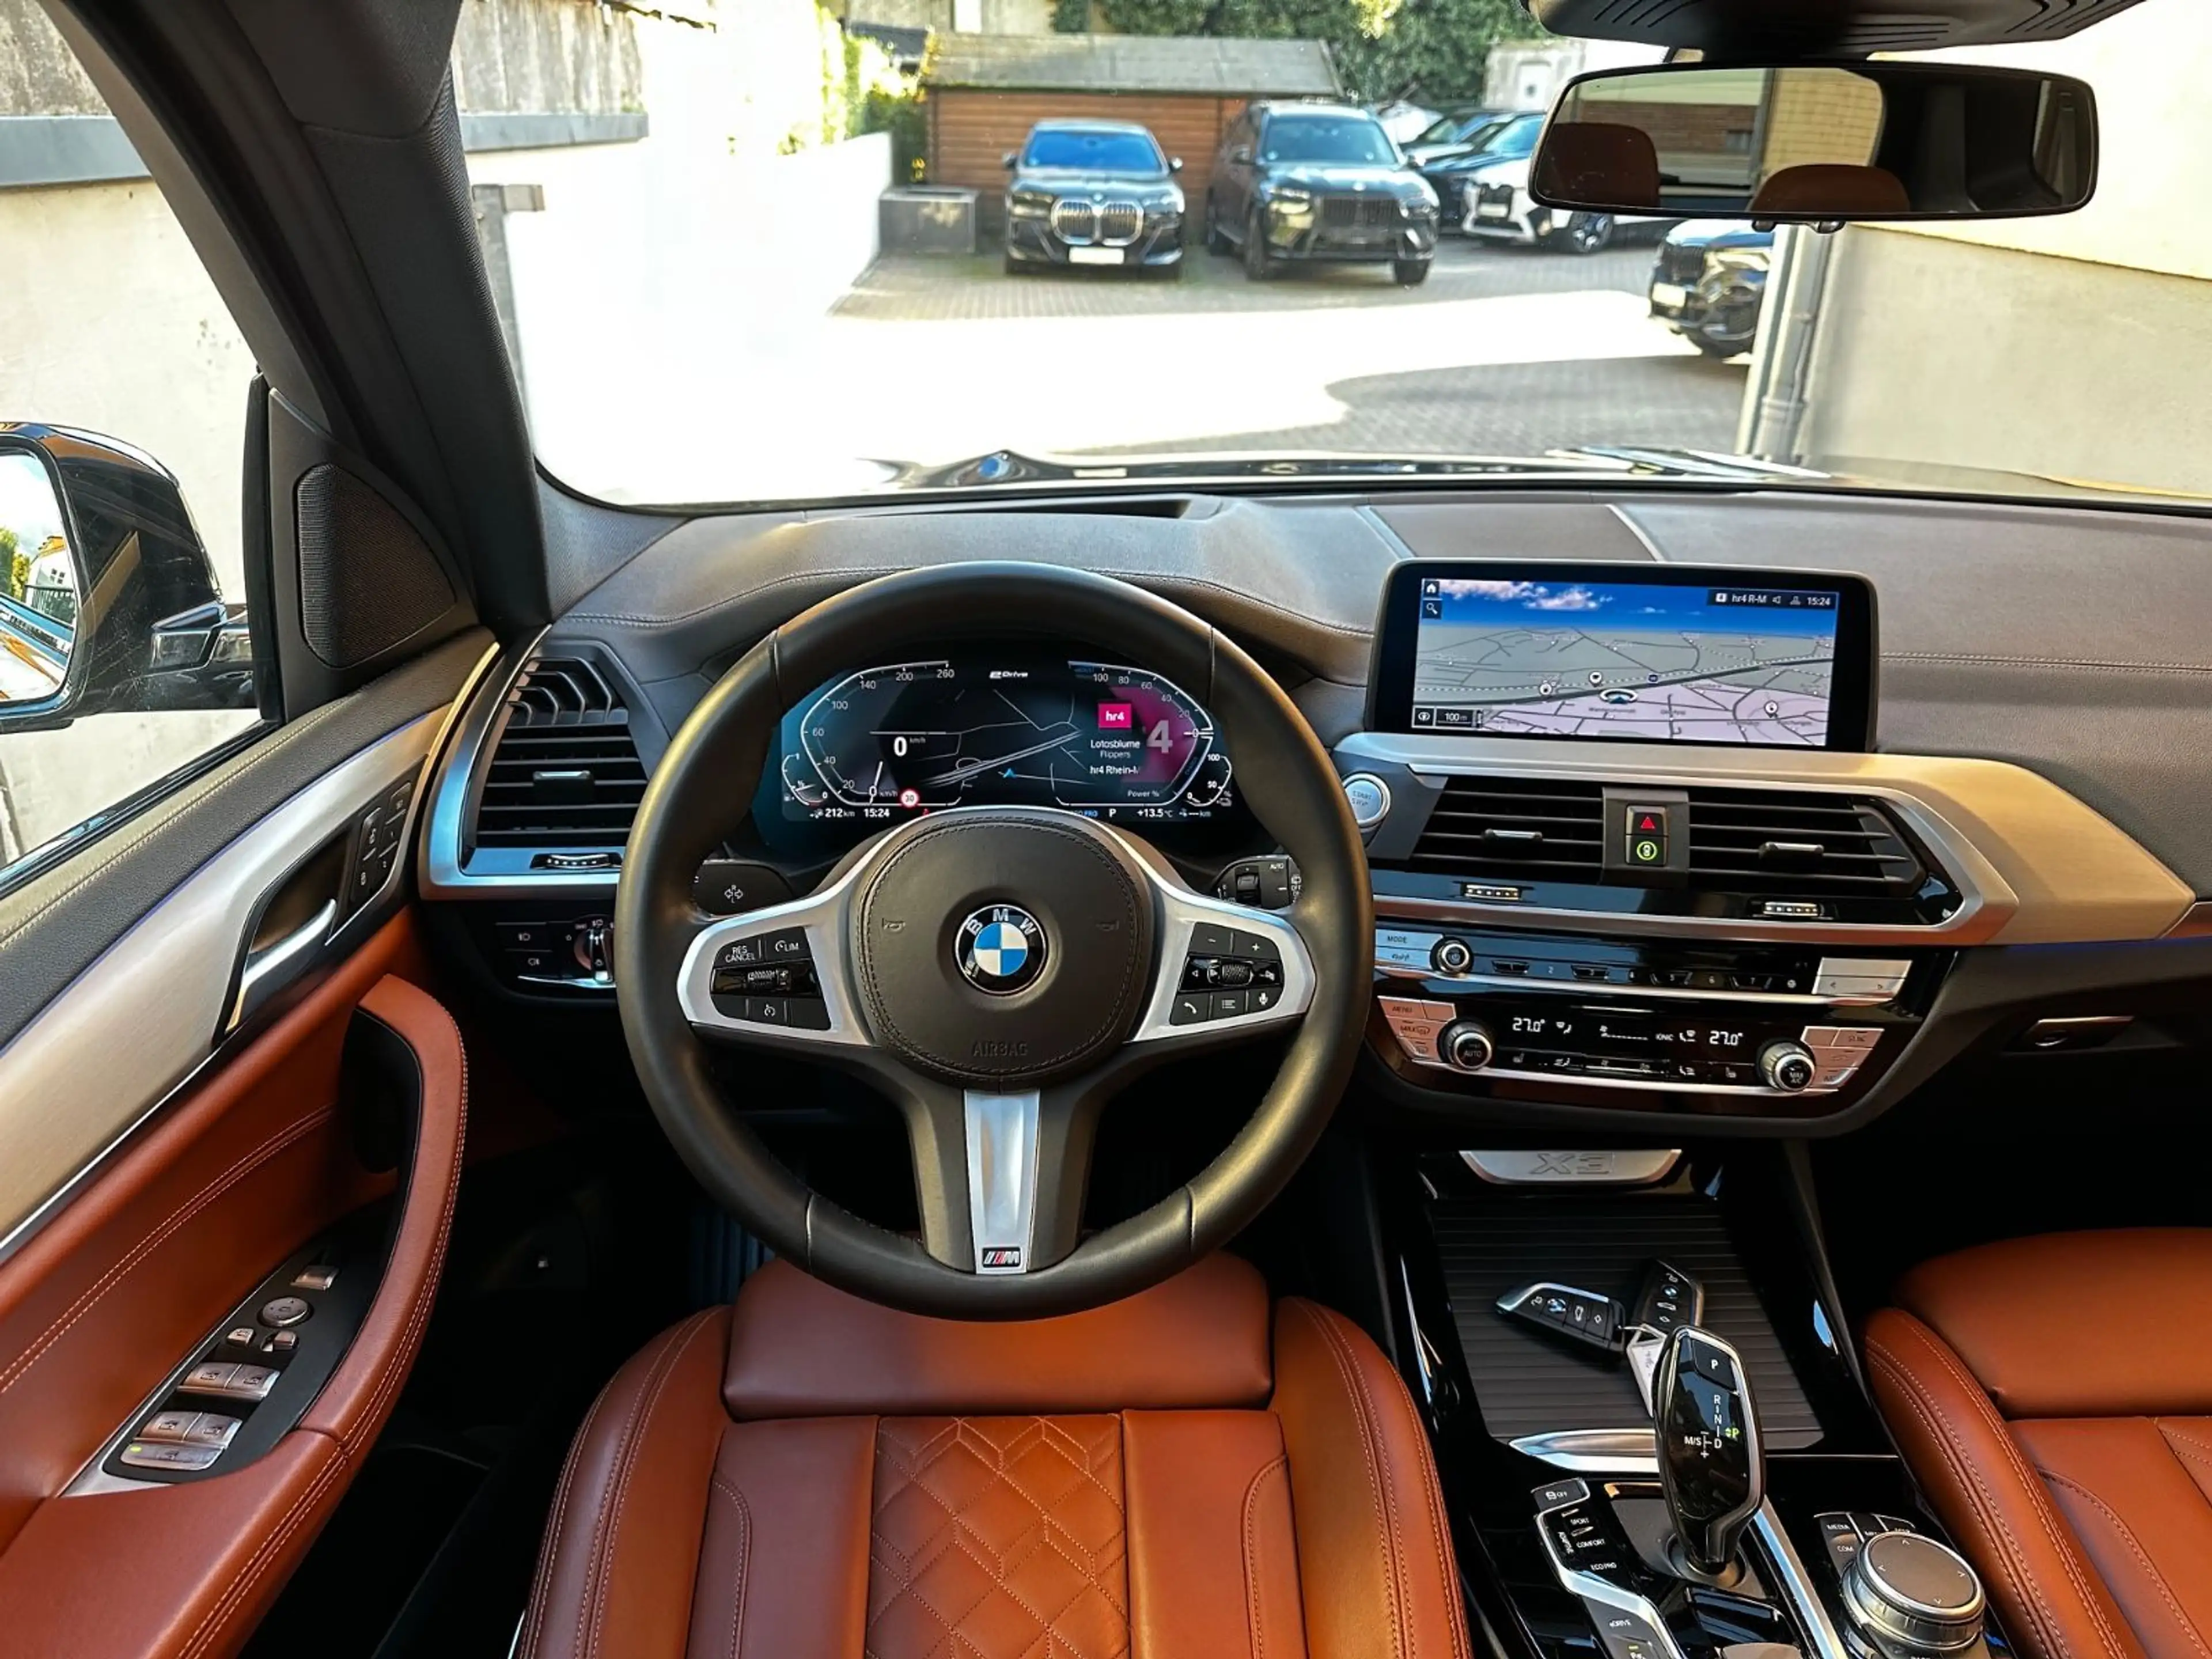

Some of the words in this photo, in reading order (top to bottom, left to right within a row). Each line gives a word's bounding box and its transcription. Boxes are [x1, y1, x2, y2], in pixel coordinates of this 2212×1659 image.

[1732, 594, 1746, 603] hr4
[1749, 596, 1767, 604] R-M
[1807, 597, 1831, 606] 15:24
[895, 672, 914, 681] 200
[937, 669, 955, 679] 260
[1093, 673, 1109, 683] 100
[859, 680, 876, 690] 140
[1118, 676, 1130, 684] 80
[1141, 681, 1153, 690] 60
[1161, 694, 1172, 702] 40
[832, 700, 849, 710] 100
[1105, 710, 1125, 721] hr4
[1179, 709, 1190, 718] 20
[1444, 711, 1460, 721] 100
[812, 727, 825, 737] 60
[1147, 720, 1173, 753] 4
[893, 736, 908, 757] 0
[1090, 739, 1141, 749] Lotosblume
[1100, 749, 1131, 759] Flippers
[1207, 753, 1221, 762] 100
[824, 756, 836, 764] 40
[1090, 764, 1104, 775] hr4
[843, 779, 855, 789] 20
[869, 785, 877, 796] 0
[1127, 789, 1150, 797] Power
[825, 808, 843, 818] 212
[863, 808, 890, 818] 15:24
[1108, 808, 1117, 818] P
[1137, 808, 1164, 818] +13.5
[1387, 935, 1407, 944] MODE
[732, 945, 748, 954] RES
[725, 952, 756, 963] CANCEL
[1512, 1017, 1546, 1032] 27.0°
[1709, 1031, 1743, 1046] 27.0°
[972, 1040, 1029, 1058] AIRBAG
[1529, 1153, 1611, 1175] X3
[1711, 1359, 1718, 1370] P
[1714, 1395, 1721, 1404] R
[1714, 1414, 1722, 1425] N
[1684, 1435, 1702, 1446] M/S
[1714, 1438, 1722, 1449] D
